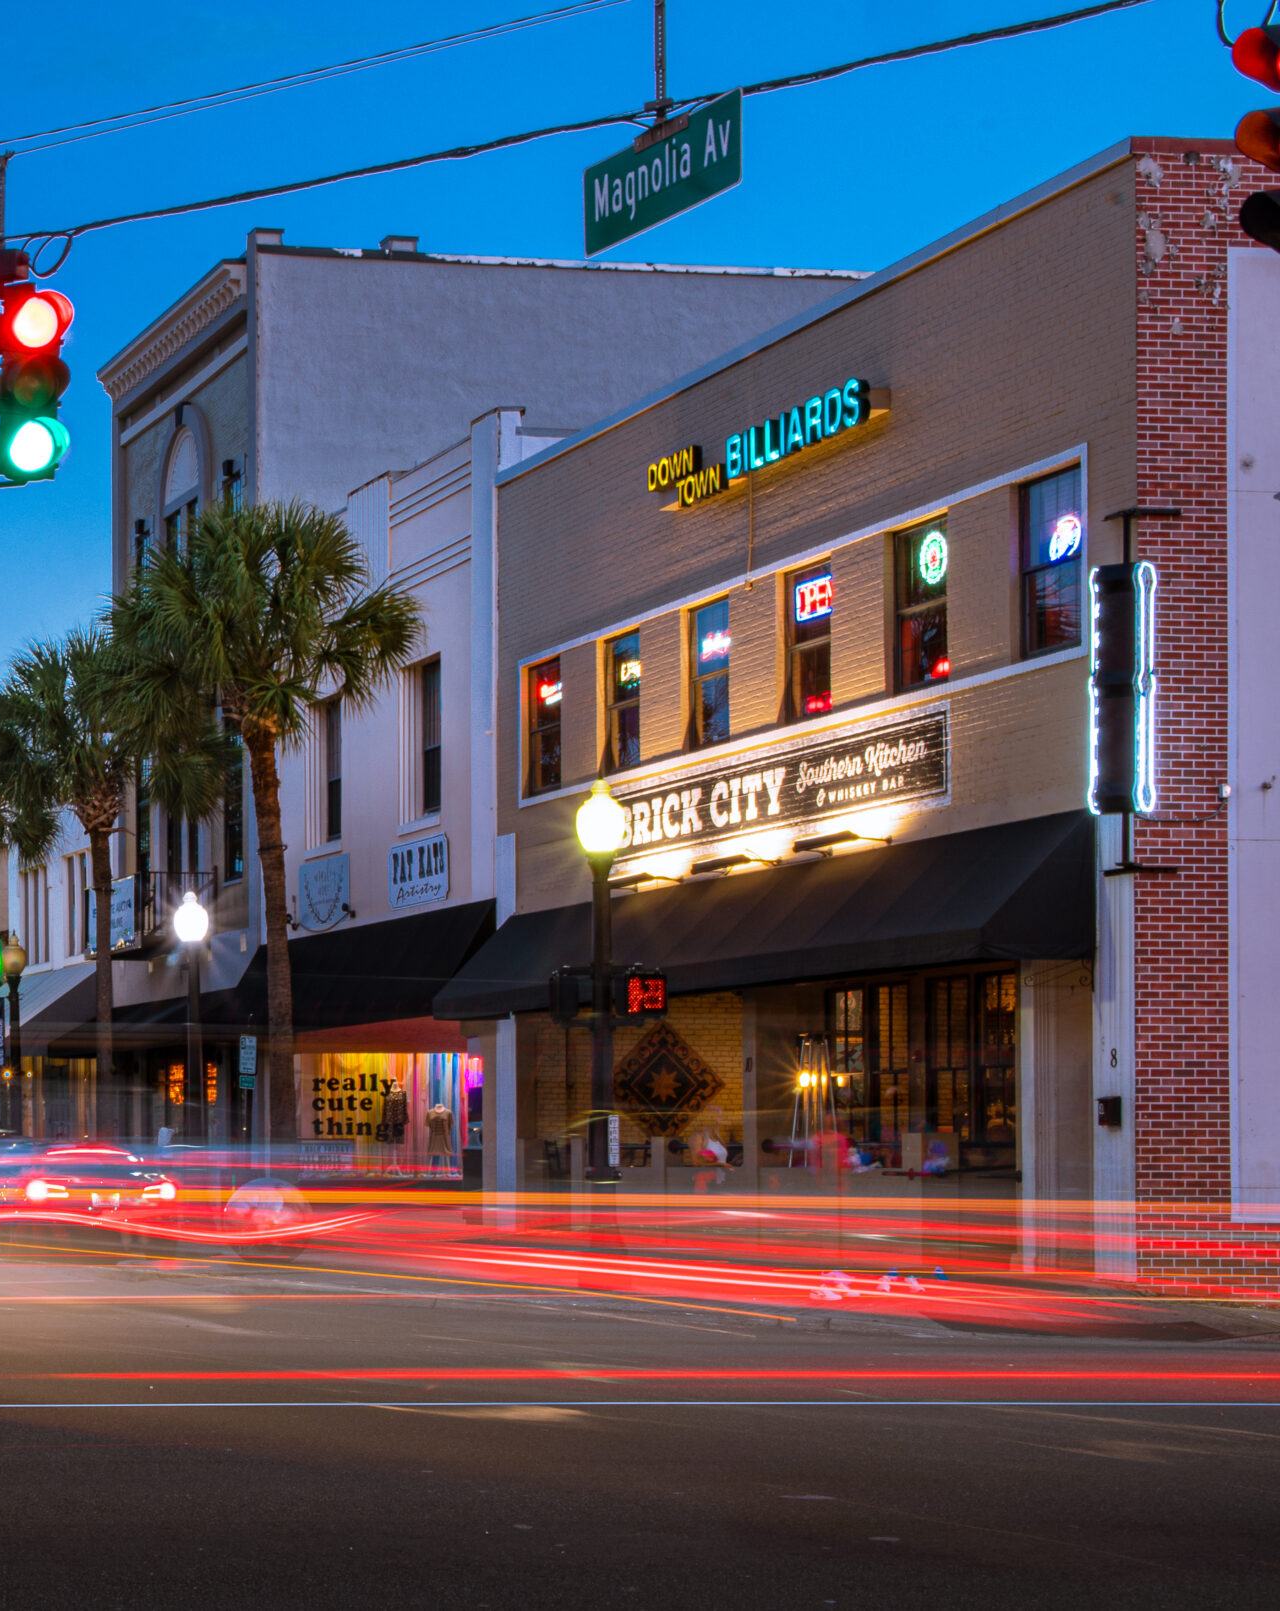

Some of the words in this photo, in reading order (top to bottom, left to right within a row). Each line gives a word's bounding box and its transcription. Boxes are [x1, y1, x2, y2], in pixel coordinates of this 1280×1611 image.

[593, 138, 691, 222] Magnolia
[703, 117, 731, 168] Av
[725, 377, 863, 480] BILLIARDS
[647, 446, 694, 492] DOWN
[676, 463, 721, 506] TOWN
[797, 579, 832, 617] OPEN
[796, 755, 864, 794] Southern
[864, 738, 927, 777] Kitchen
[709, 766, 787, 828] CITY
[827, 781, 877, 804] WHISKEY
[882, 775, 905, 792] BAR
[417, 841, 445, 879] KATS
[396, 881, 441, 904] Artistry
[1110, 1048, 1118, 1068] 8
[312, 1073, 396, 1097] really
[312, 1097, 373, 1112] cute
[312, 1117, 405, 1142] things
